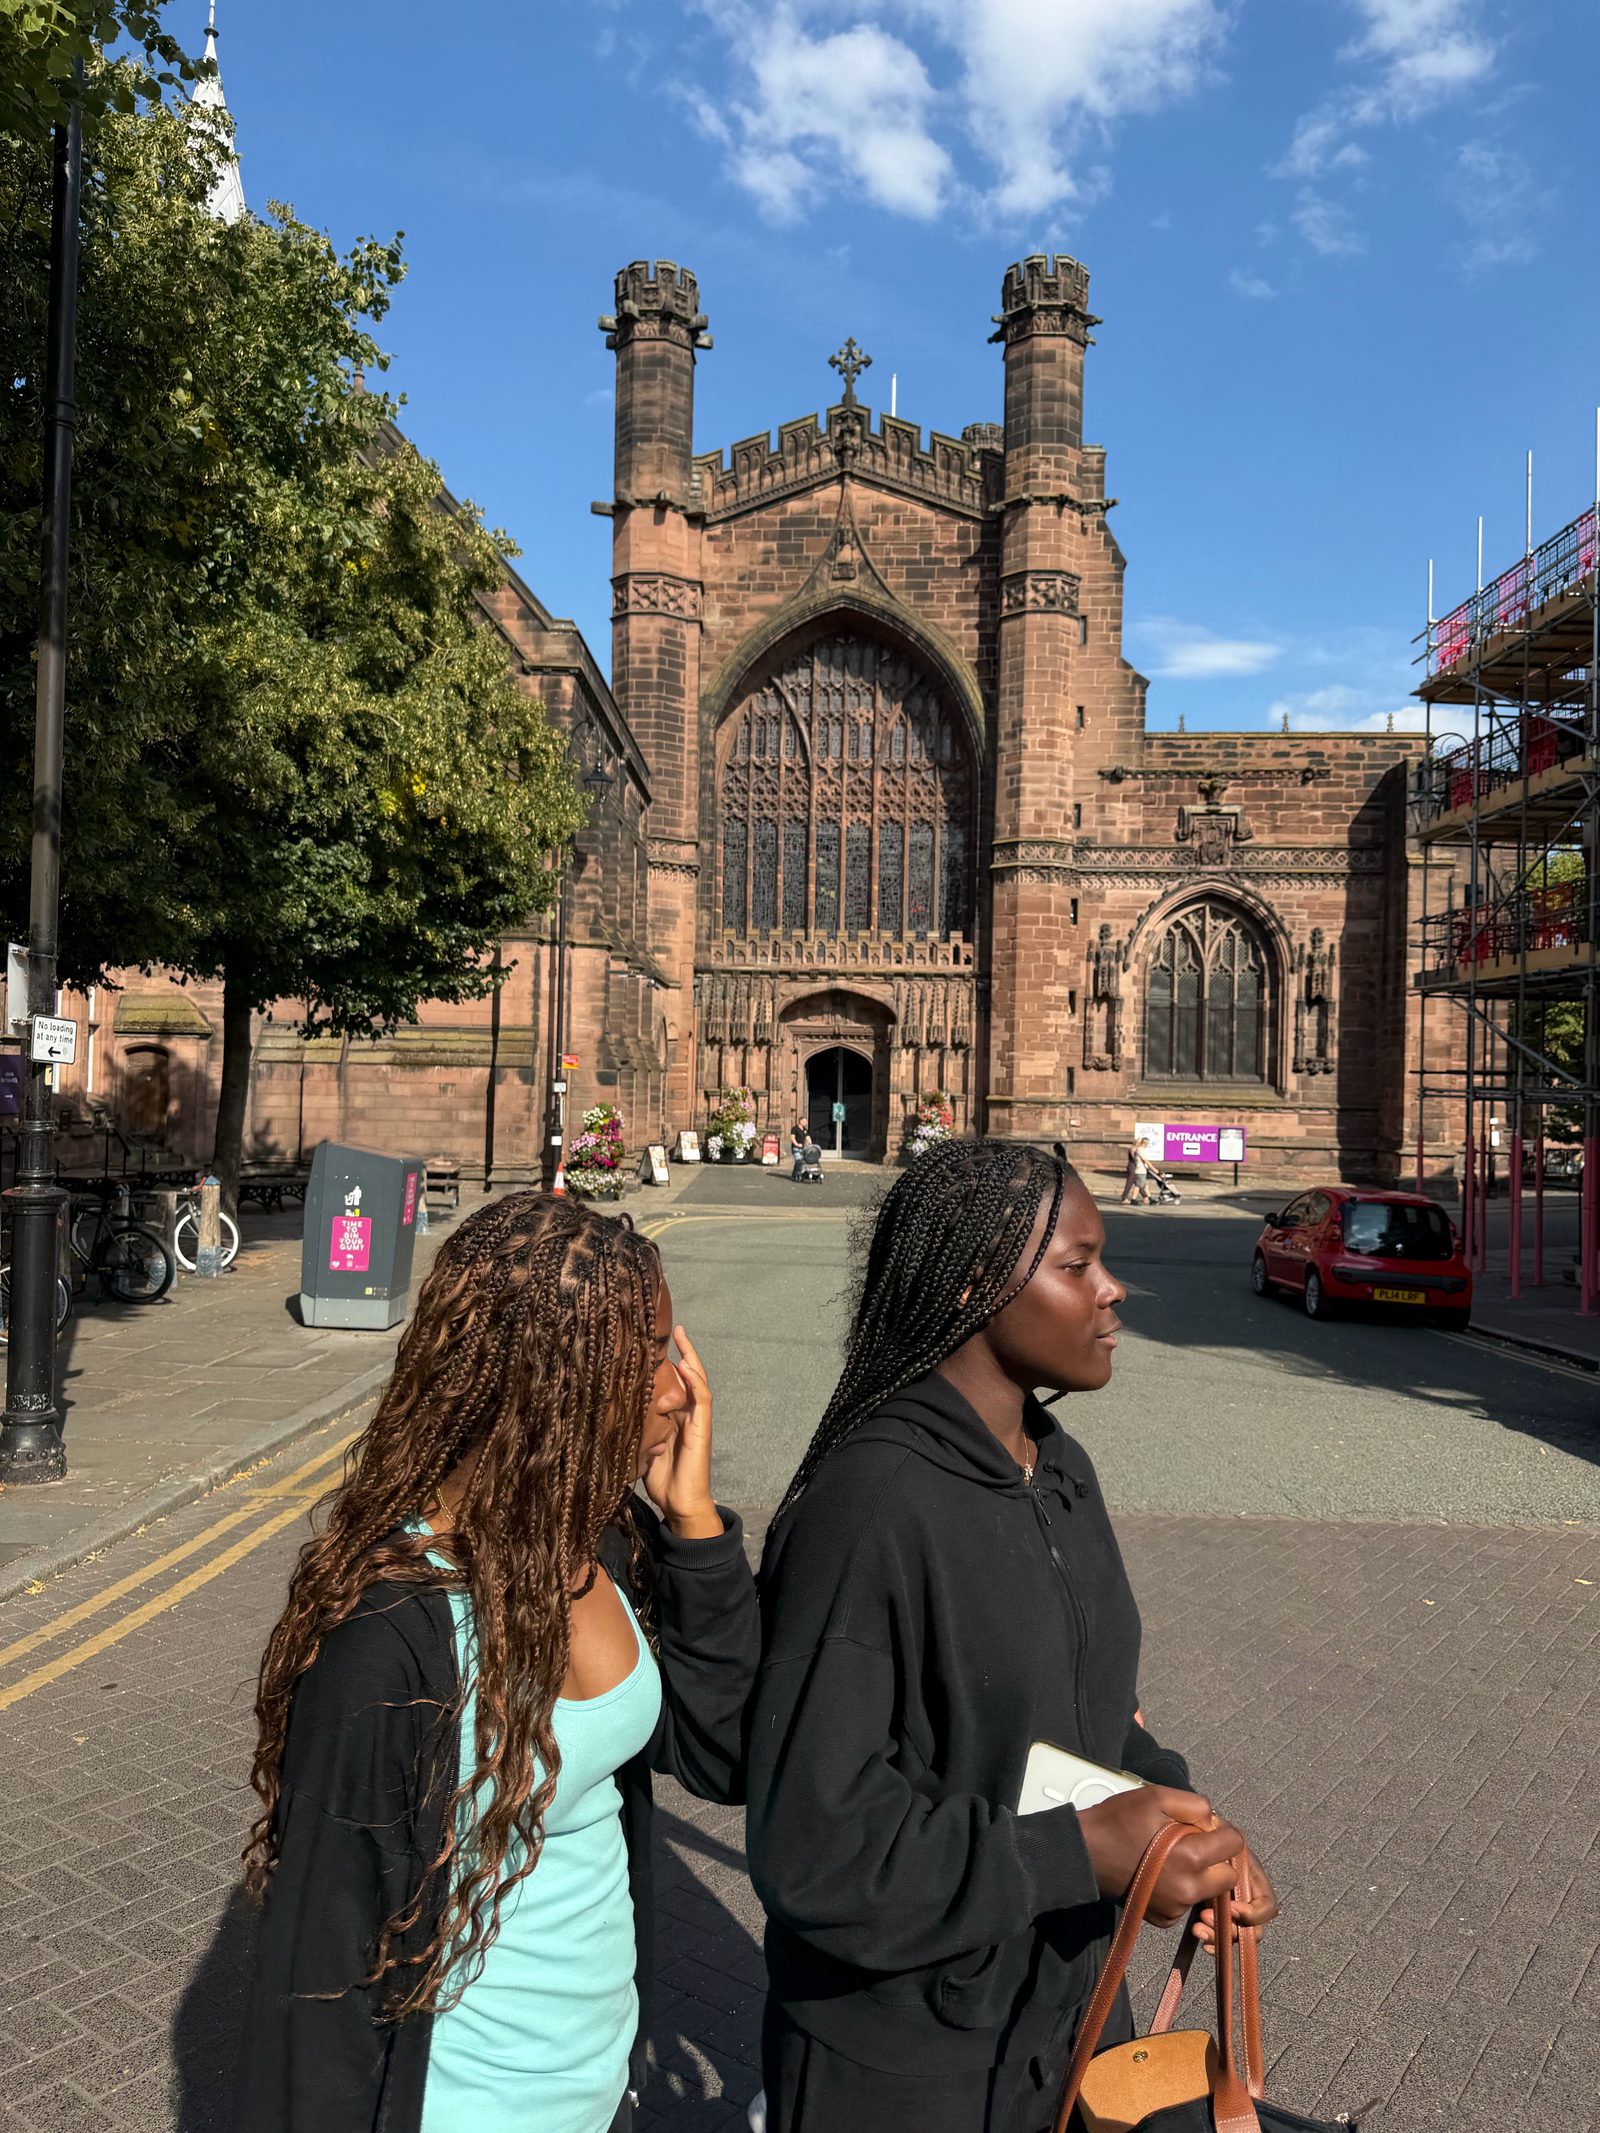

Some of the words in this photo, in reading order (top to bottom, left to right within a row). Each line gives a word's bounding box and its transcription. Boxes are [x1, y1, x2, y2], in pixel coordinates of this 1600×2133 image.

[38, 1021, 48, 1030] No
[50, 1022, 73, 1035] loading
[36, 1032, 44, 1040] at
[45, 1034, 57, 1043] any
[59, 1034, 73, 1044] time
[1166, 1132, 1217, 1142] ENTRANCE
